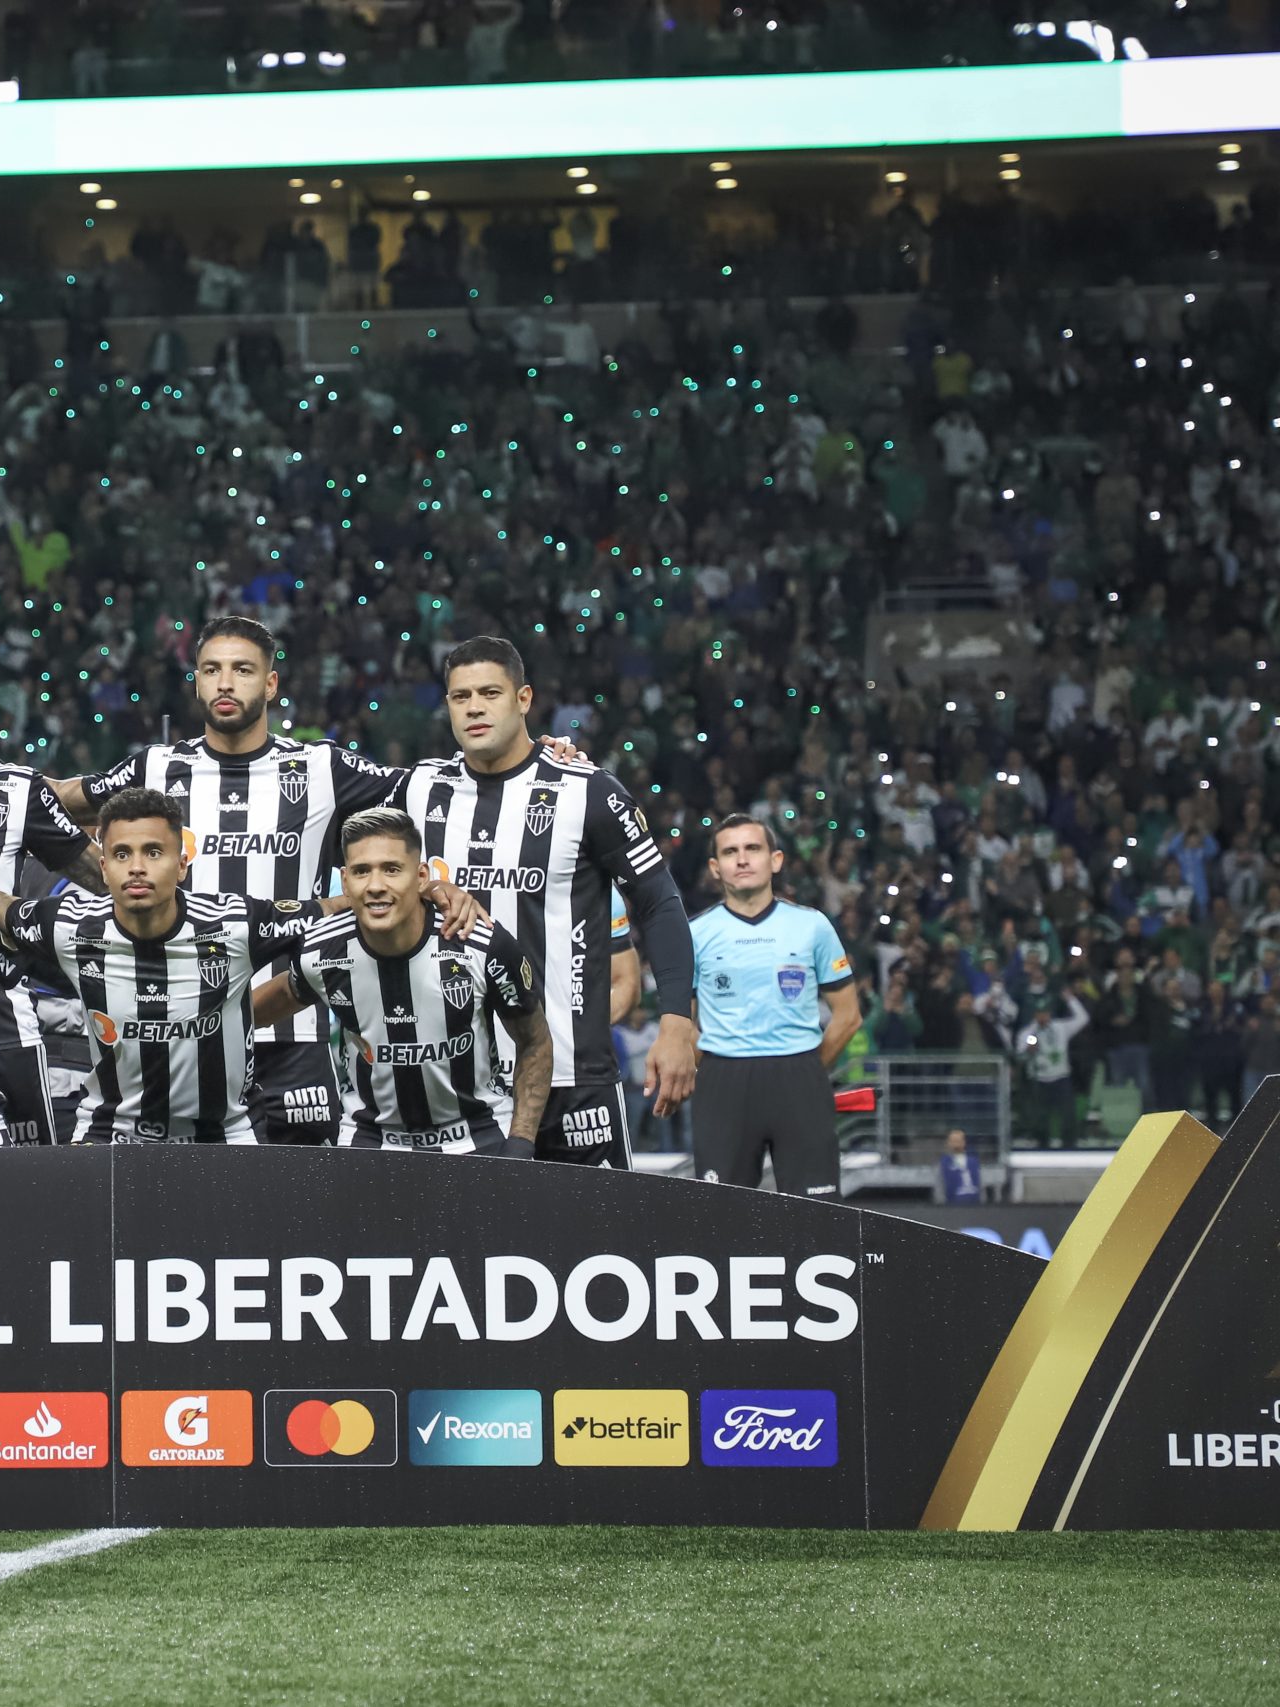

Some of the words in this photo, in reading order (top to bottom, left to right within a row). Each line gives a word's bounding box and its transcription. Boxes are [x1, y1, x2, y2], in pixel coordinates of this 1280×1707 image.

[105, 759, 136, 791] MRV
[49, 803, 81, 838] MRV
[619, 810, 640, 842] MR
[201, 833, 301, 857] BETANO
[455, 867, 544, 891] BETANO
[572, 954, 586, 1016] buser
[136, 993, 170, 1004] hapvida
[122, 1013, 220, 1041] BETANO
[384, 1015, 418, 1026] hapvida
[376, 1034, 474, 1065] BETANO
[283, 1086, 328, 1107] AUTO
[286, 1106, 332, 1123] TRUCK
[563, 1105, 611, 1131] AUTO
[10, 1120, 39, 1142] UTO
[385, 1125, 465, 1147] GERDAU
[565, 1126, 613, 1148] TRUCK
[50, 1253, 859, 1343] LIBERTADORES
[445, 1416, 532, 1439] Rexona
[590, 1417, 682, 1439] betfair
[714, 1406, 824, 1450] Ford
[149, 1449, 224, 1461] GATORADE
